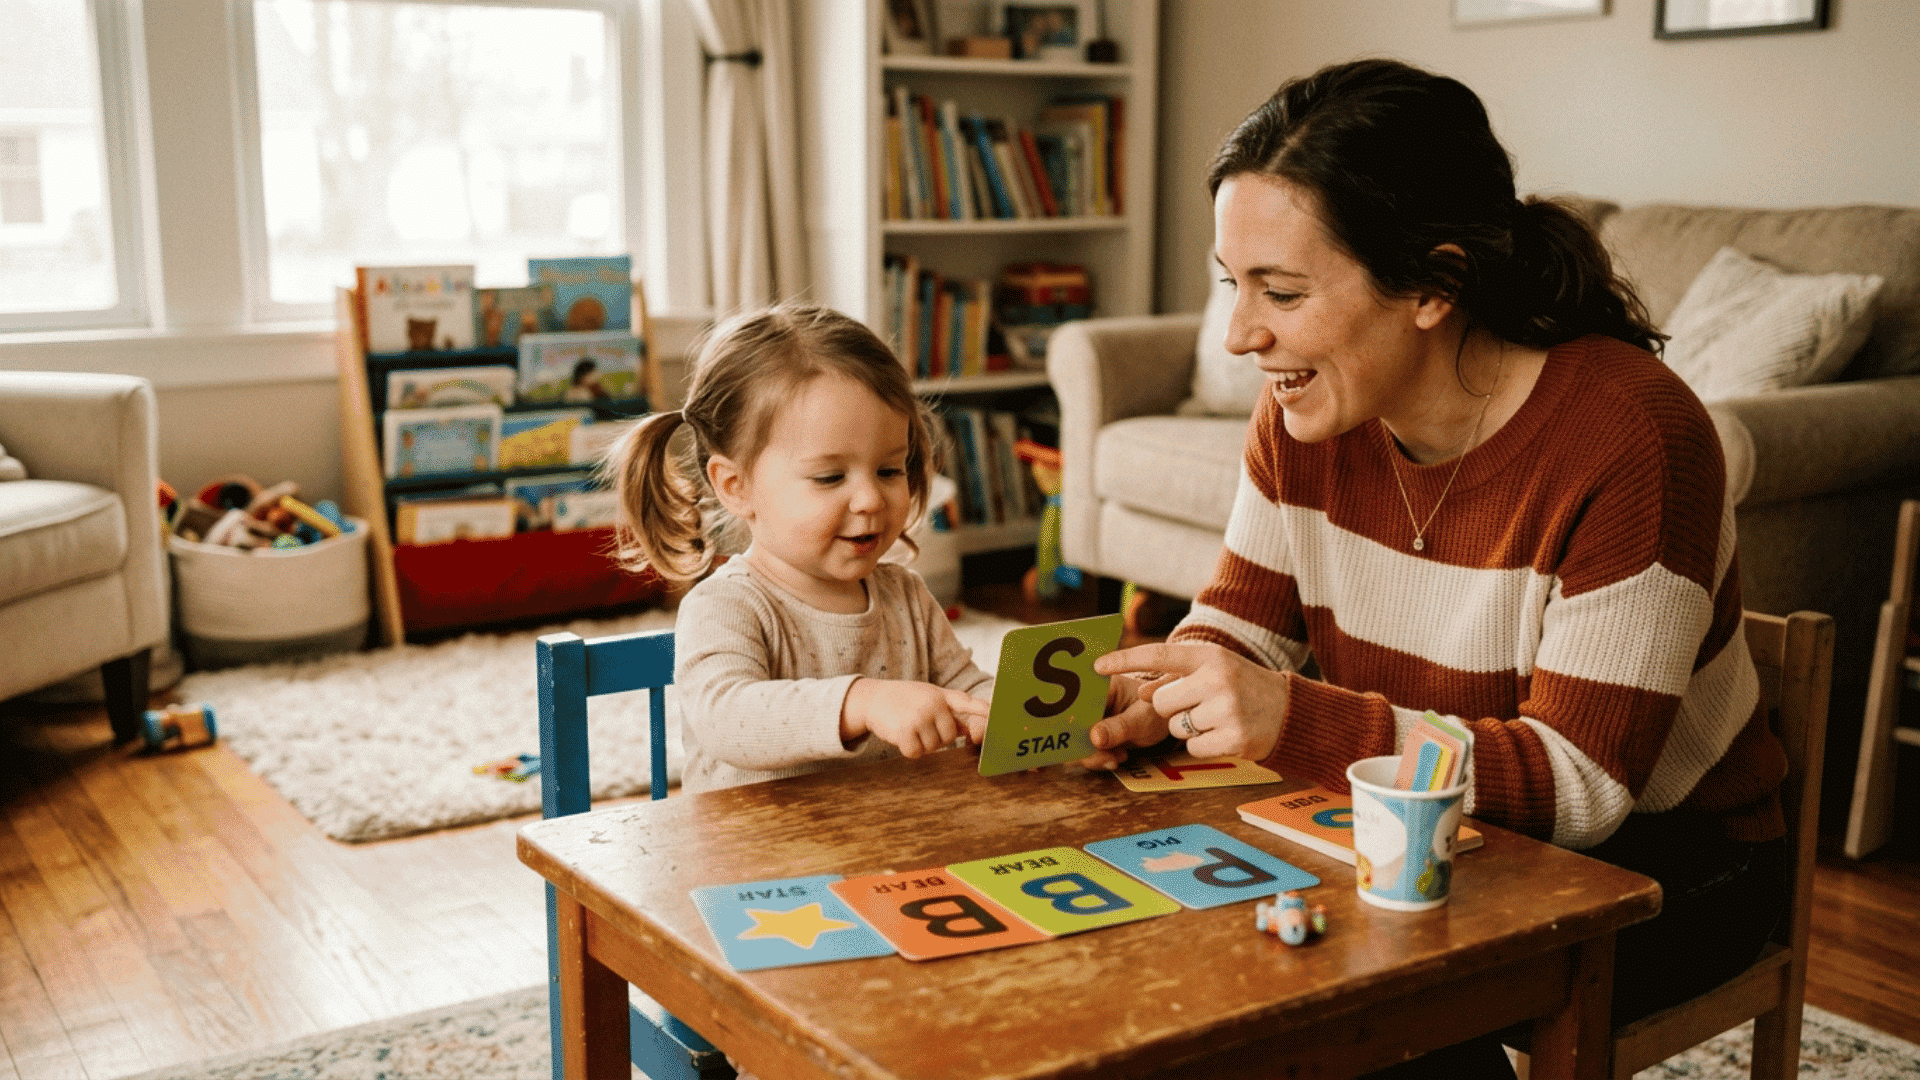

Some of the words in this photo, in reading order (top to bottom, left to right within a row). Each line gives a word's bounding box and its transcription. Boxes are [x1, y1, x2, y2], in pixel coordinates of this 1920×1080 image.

[1023, 636, 1085, 719] S
[1016, 731, 1071, 757] STAR
[1192, 847, 1278, 888] P
[738, 885, 808, 902] STAR
[1020, 872, 1133, 915] B
[900, 894, 1008, 939] B
